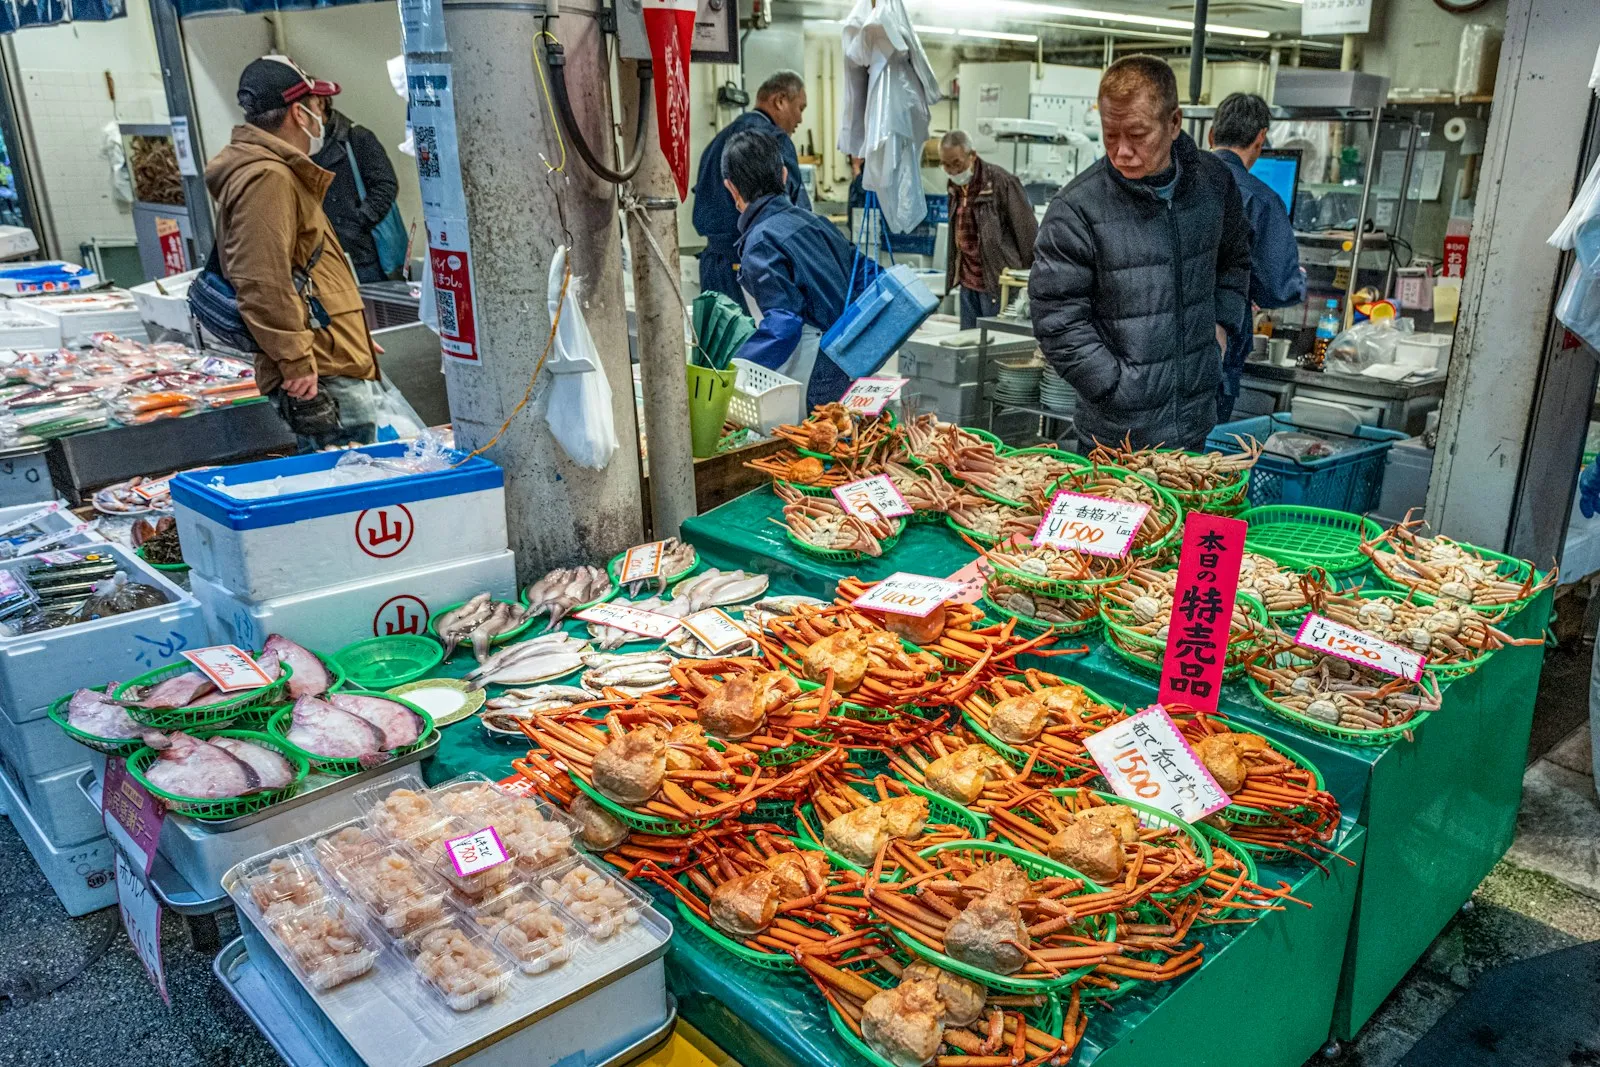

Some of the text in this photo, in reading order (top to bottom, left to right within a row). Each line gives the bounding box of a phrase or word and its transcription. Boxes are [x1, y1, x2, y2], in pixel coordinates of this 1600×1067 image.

[367, 510, 402, 547] 山
[1047, 517, 1105, 544] ¥1500
[1168, 530, 1227, 698] 本日の特売品
[1311, 628, 1382, 660] ¥1500
